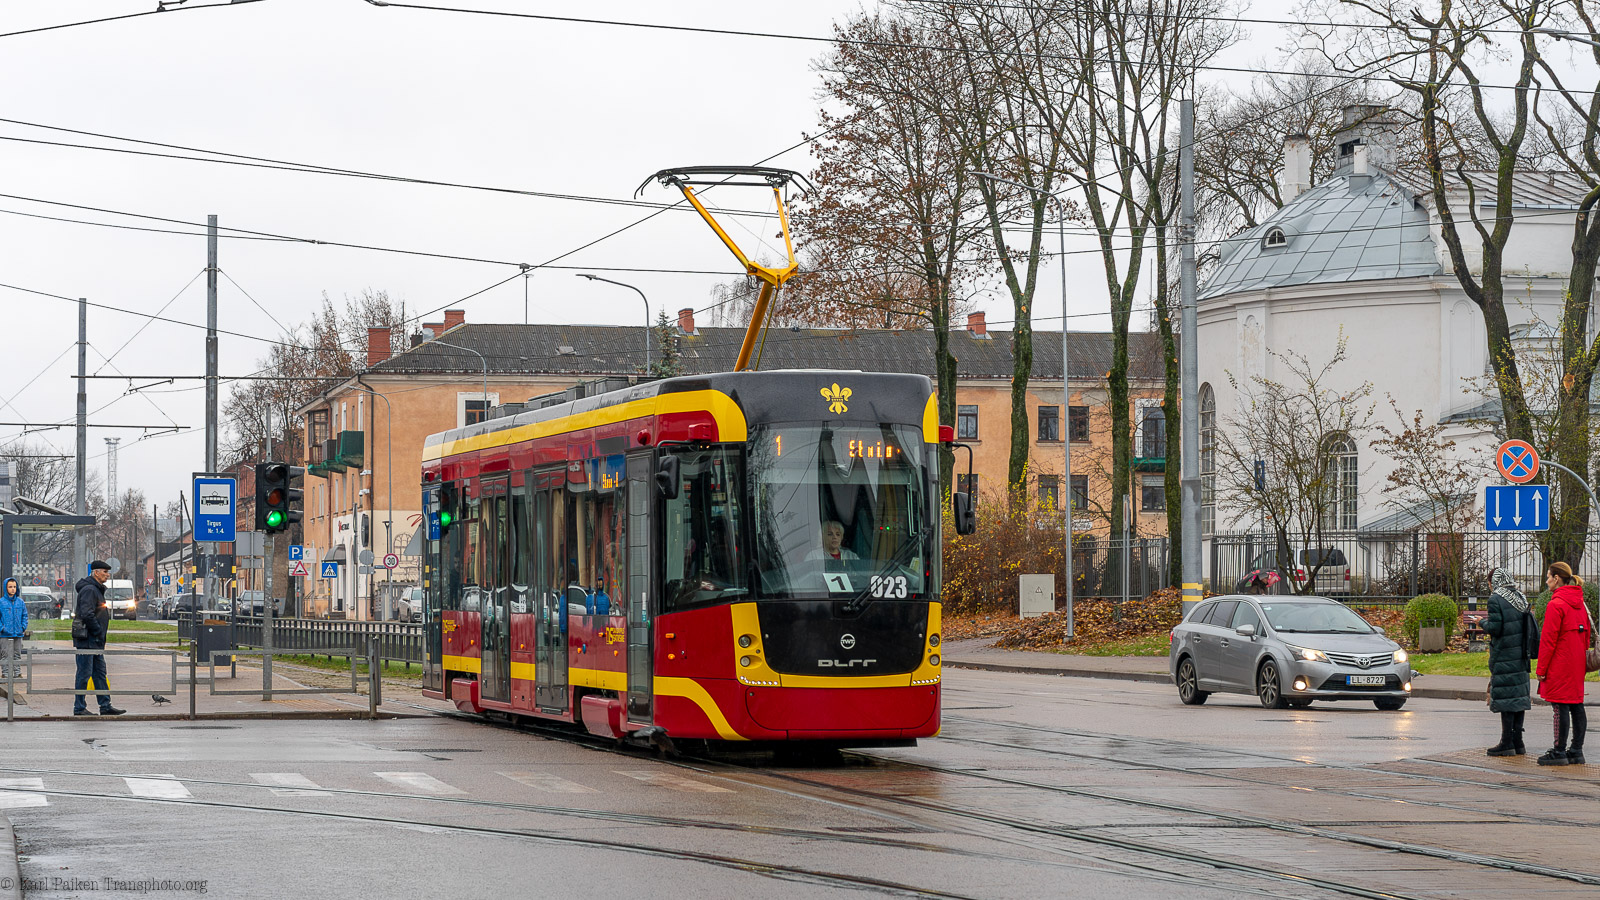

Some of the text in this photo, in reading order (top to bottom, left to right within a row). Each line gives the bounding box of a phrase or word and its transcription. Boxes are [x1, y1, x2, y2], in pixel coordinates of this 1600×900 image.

[775, 434, 781, 456] 1
[206, 519, 222, 528] Tirgus
[291, 546, 300, 559] P
[387, 557, 396, 565] 30
[830, 575, 846, 591] 1
[870, 575, 908, 599] 023
